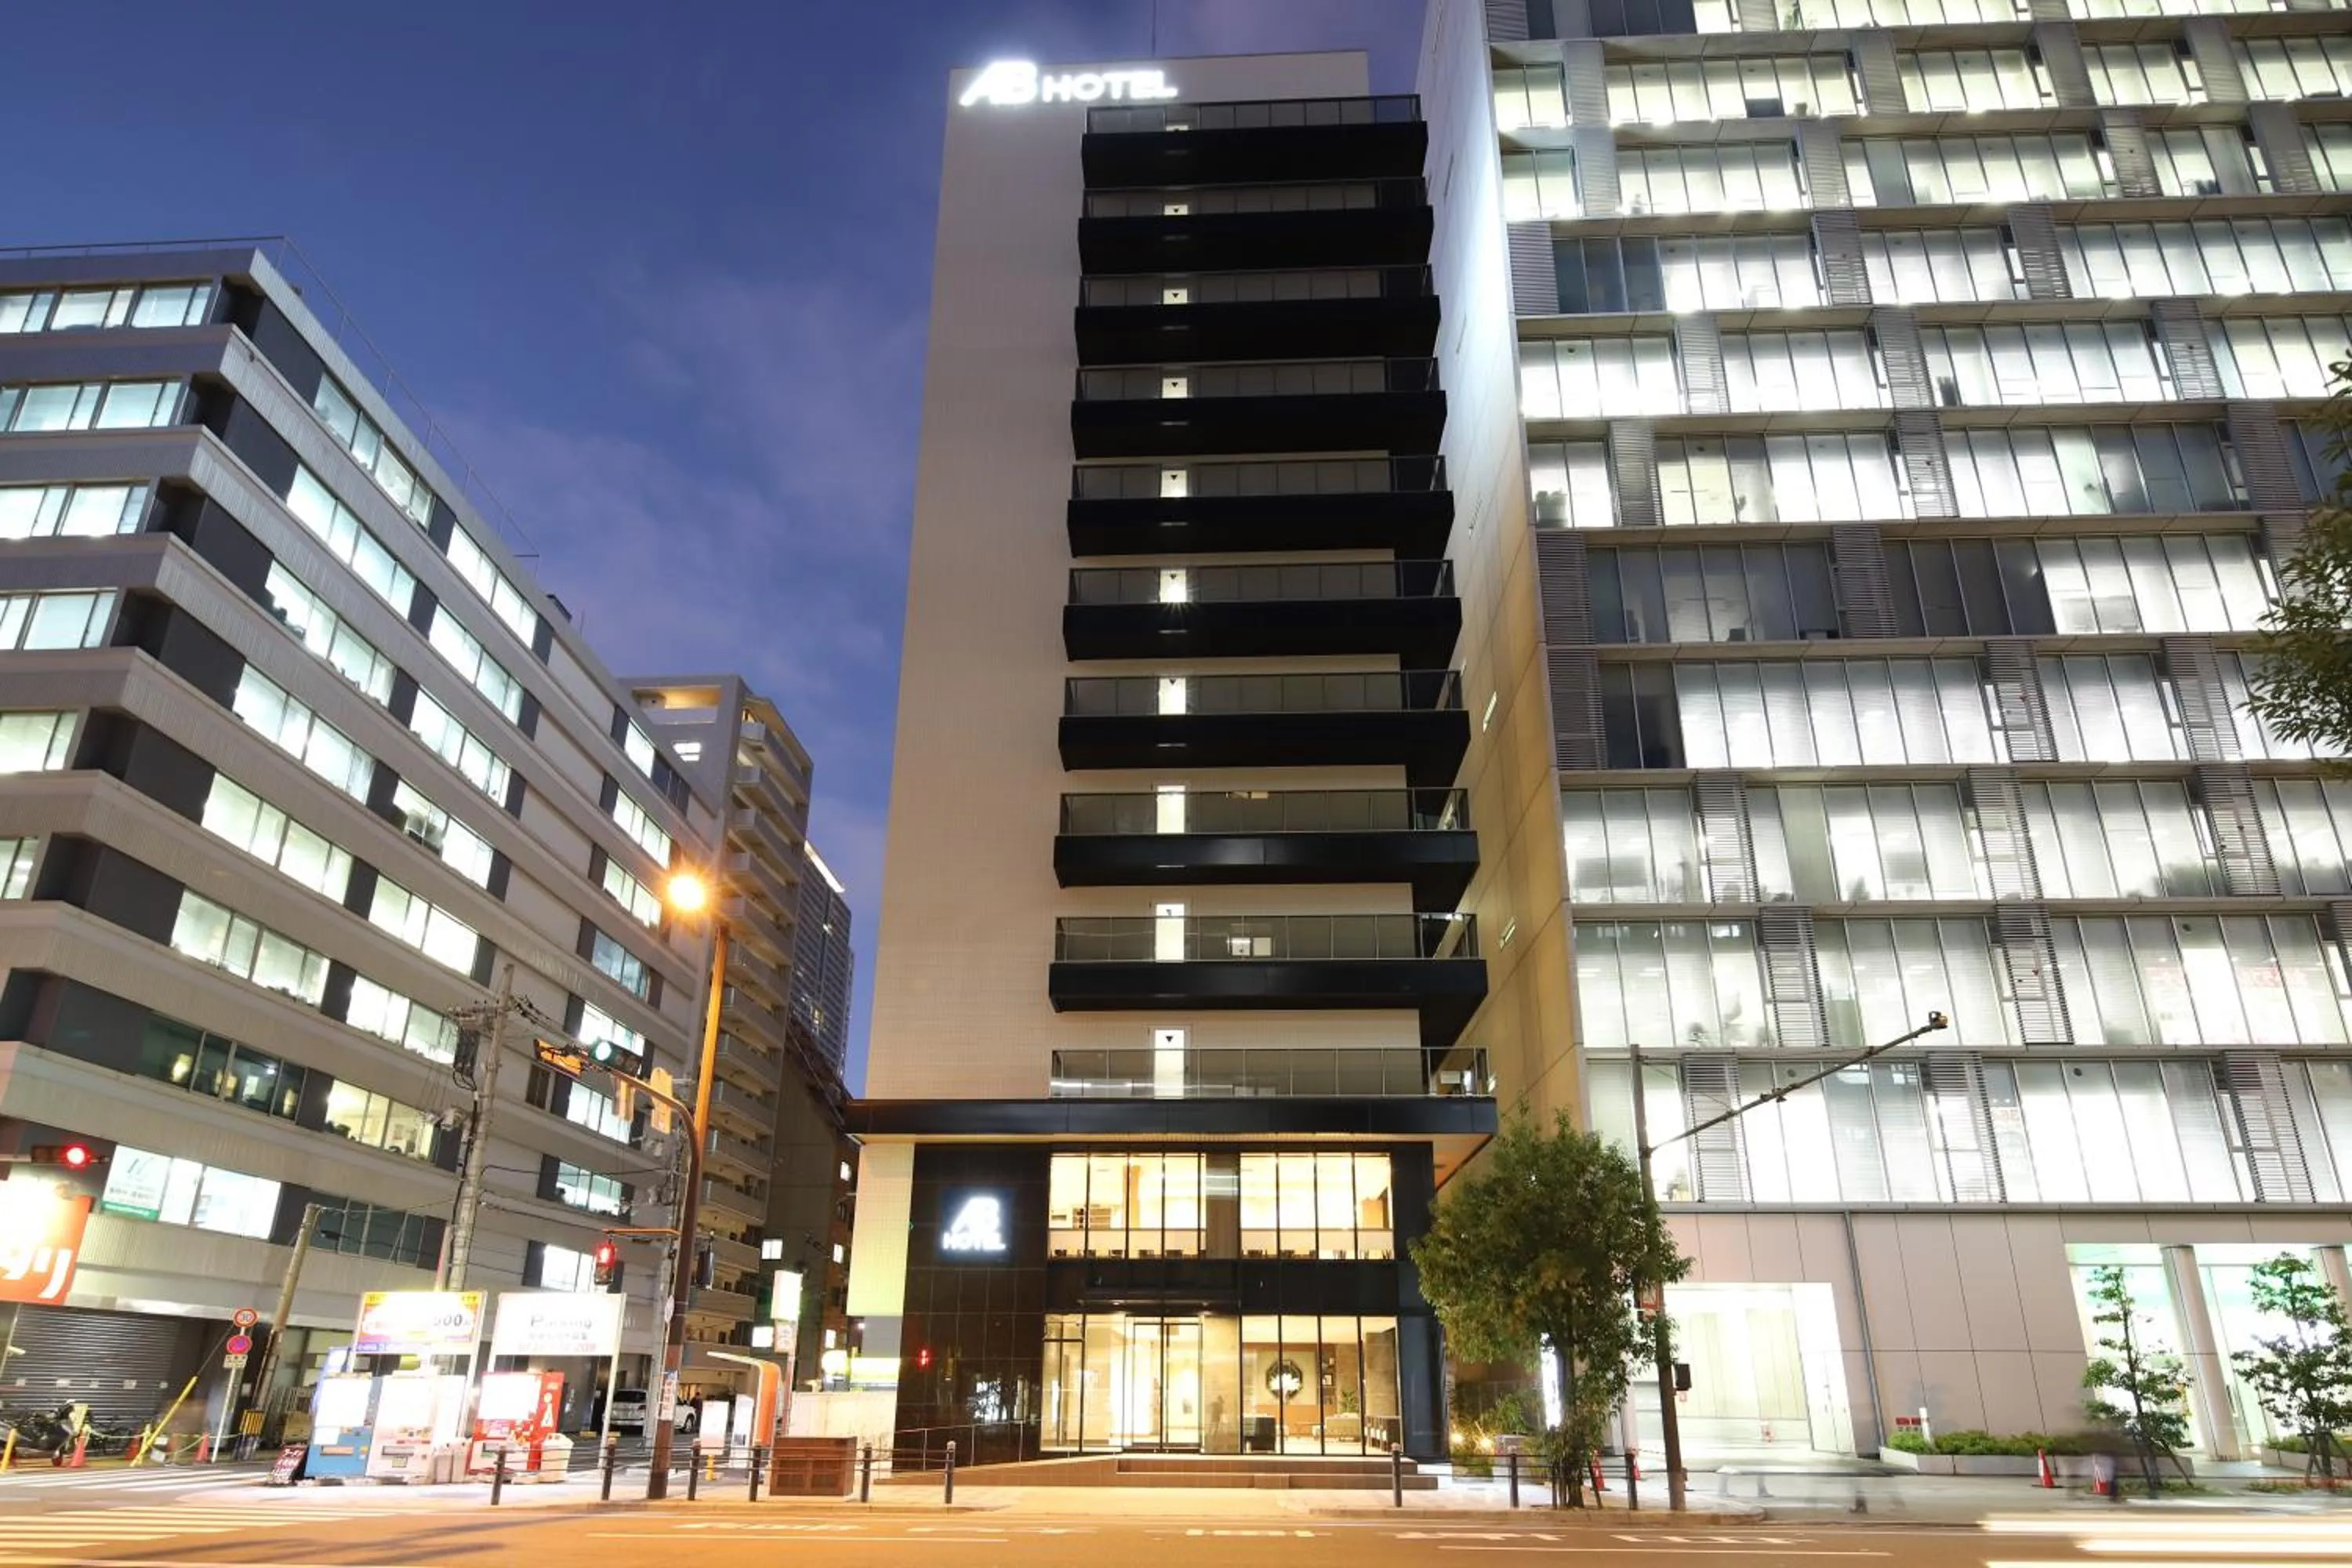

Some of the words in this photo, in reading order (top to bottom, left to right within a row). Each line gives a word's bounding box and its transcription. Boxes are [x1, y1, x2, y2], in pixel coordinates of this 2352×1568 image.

[960, 61, 1037, 106] AB
[1042, 71, 1178, 102] HOTEL
[951, 1197, 999, 1236] AB
[943, 1232, 1006, 1250] HOTEL
